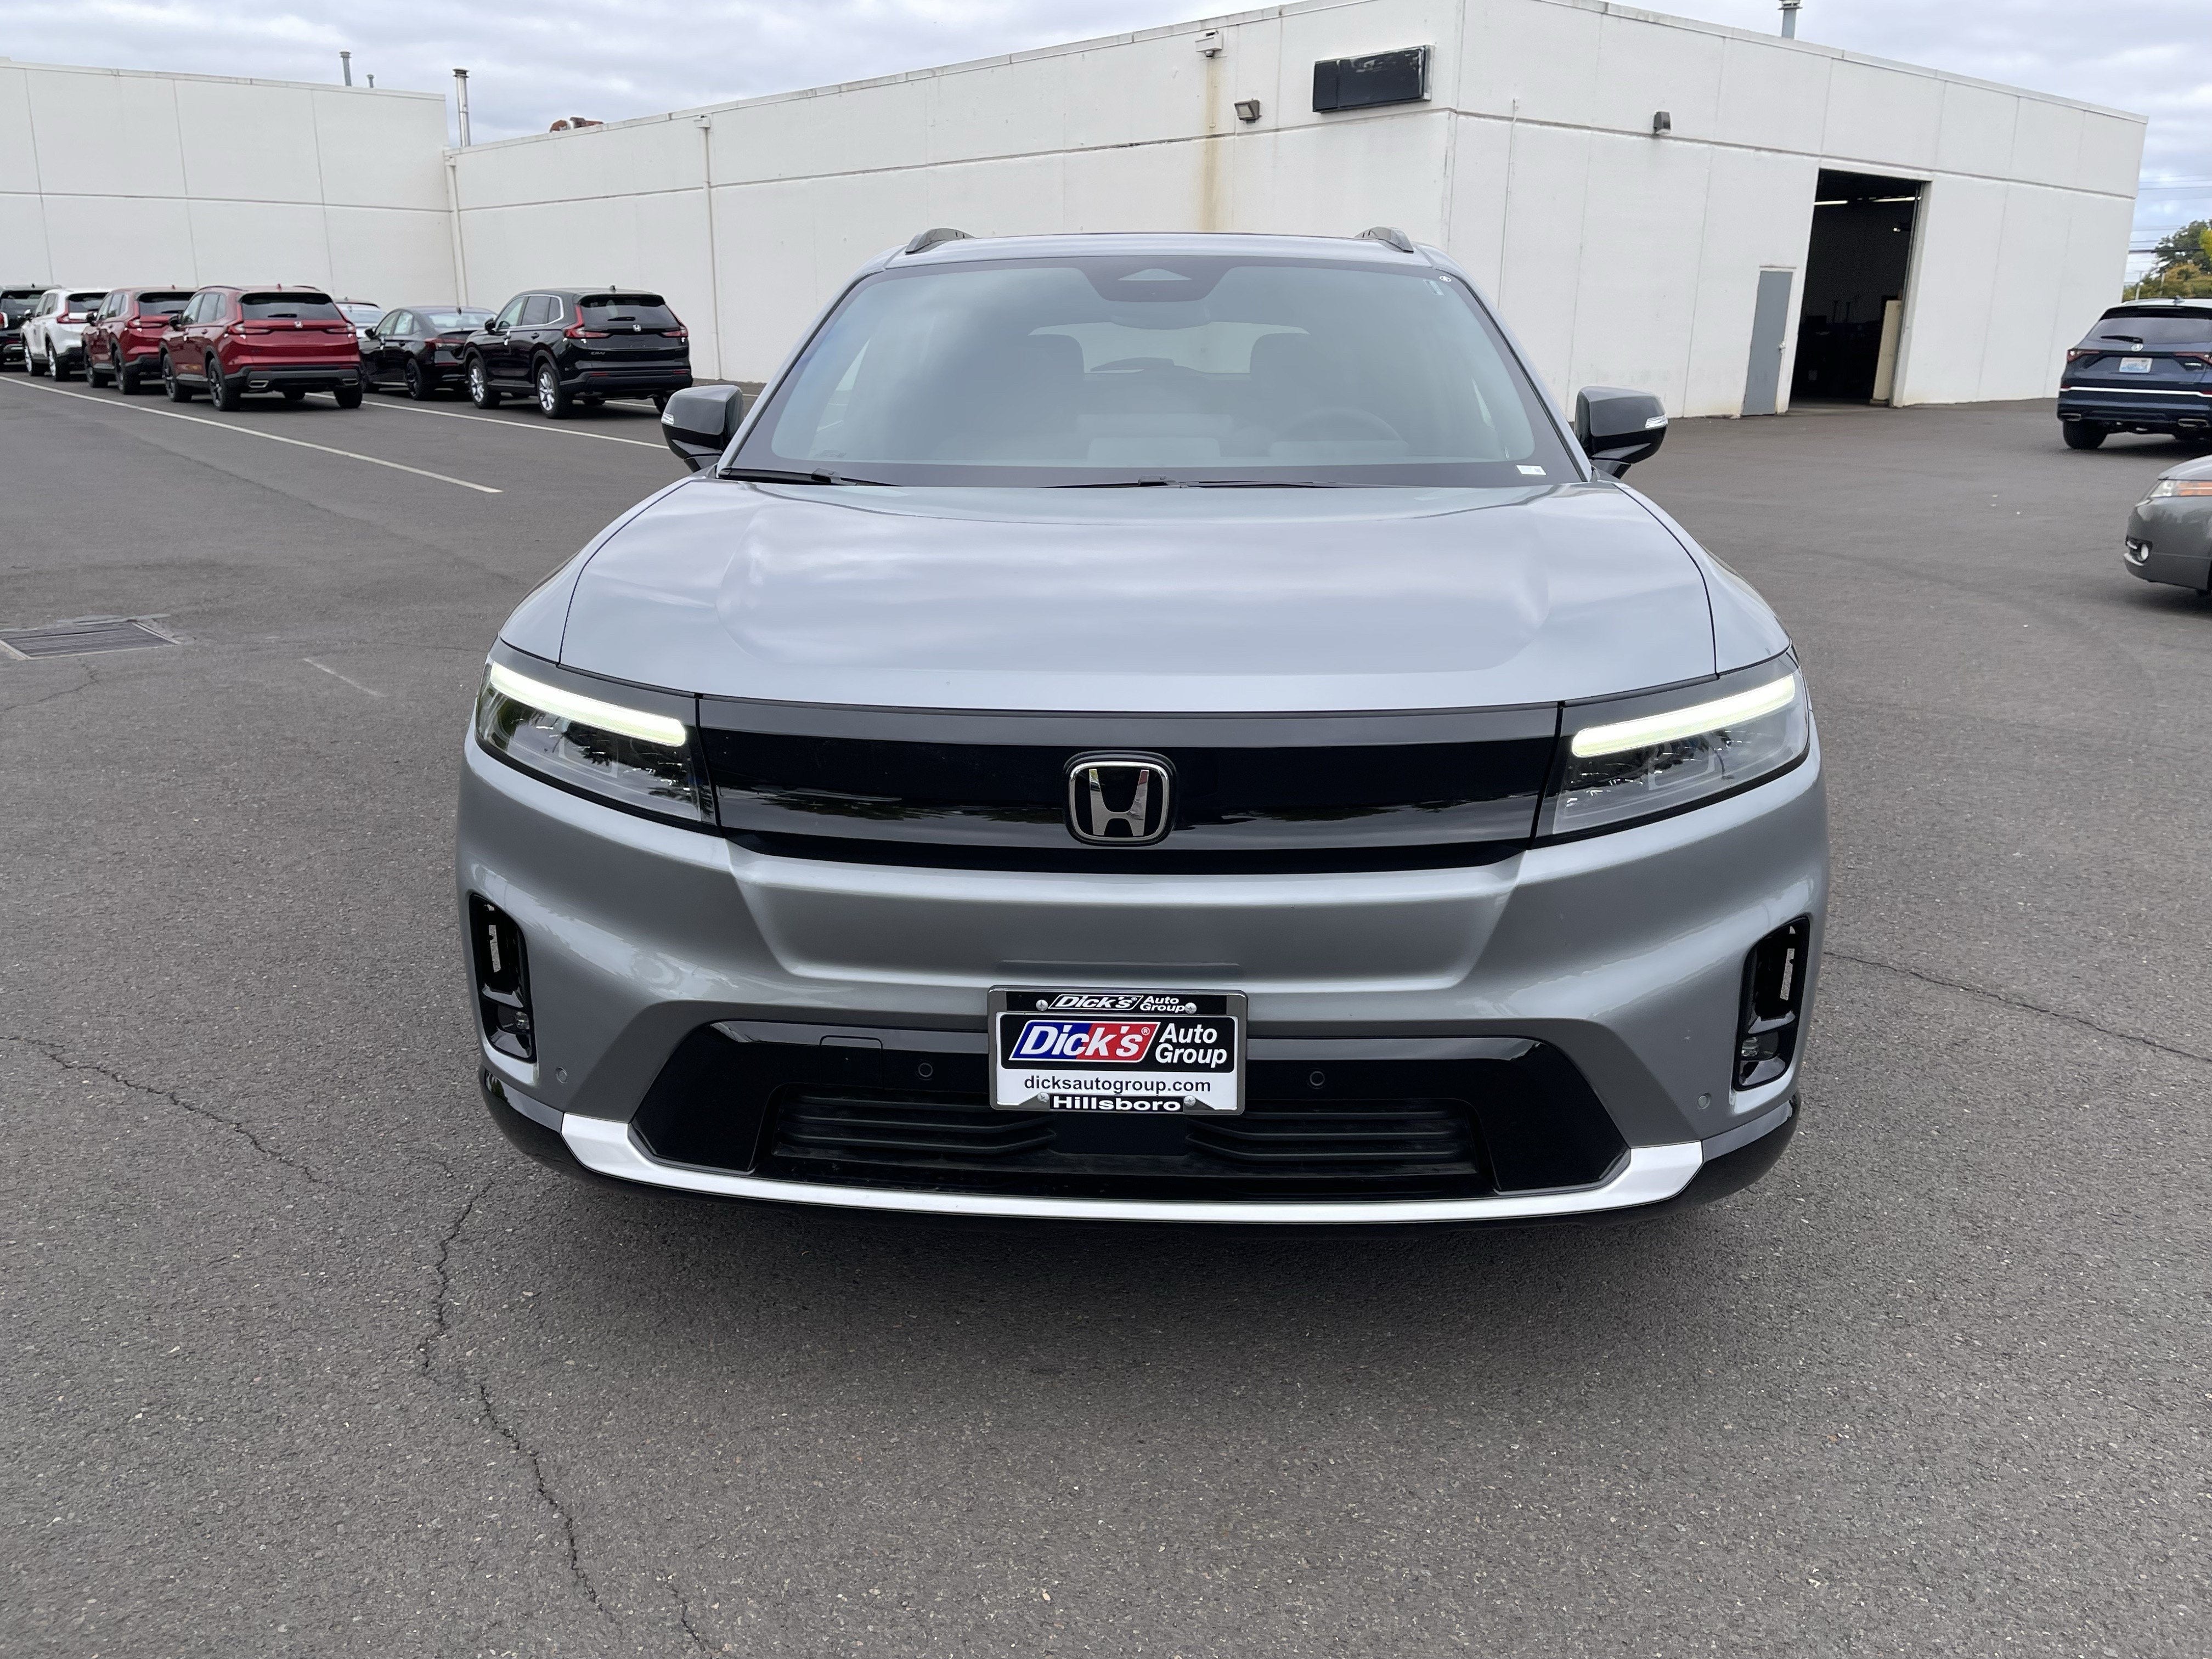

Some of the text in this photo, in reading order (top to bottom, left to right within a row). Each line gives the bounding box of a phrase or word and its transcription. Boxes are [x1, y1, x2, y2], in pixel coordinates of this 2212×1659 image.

[1054, 996, 1133, 1008] Dick's
[1139, 1003, 1185, 1013] Group
[1143, 996, 1180, 1005] Auto
[1019, 1024, 1143, 1057] Dick's
[1159, 1023, 1218, 1043] Auto
[1155, 1043, 1228, 1068] Group
[1024, 1075, 1211, 1094] dicksautogroup.com
[1052, 1096, 1182, 1111] Hillsboro
